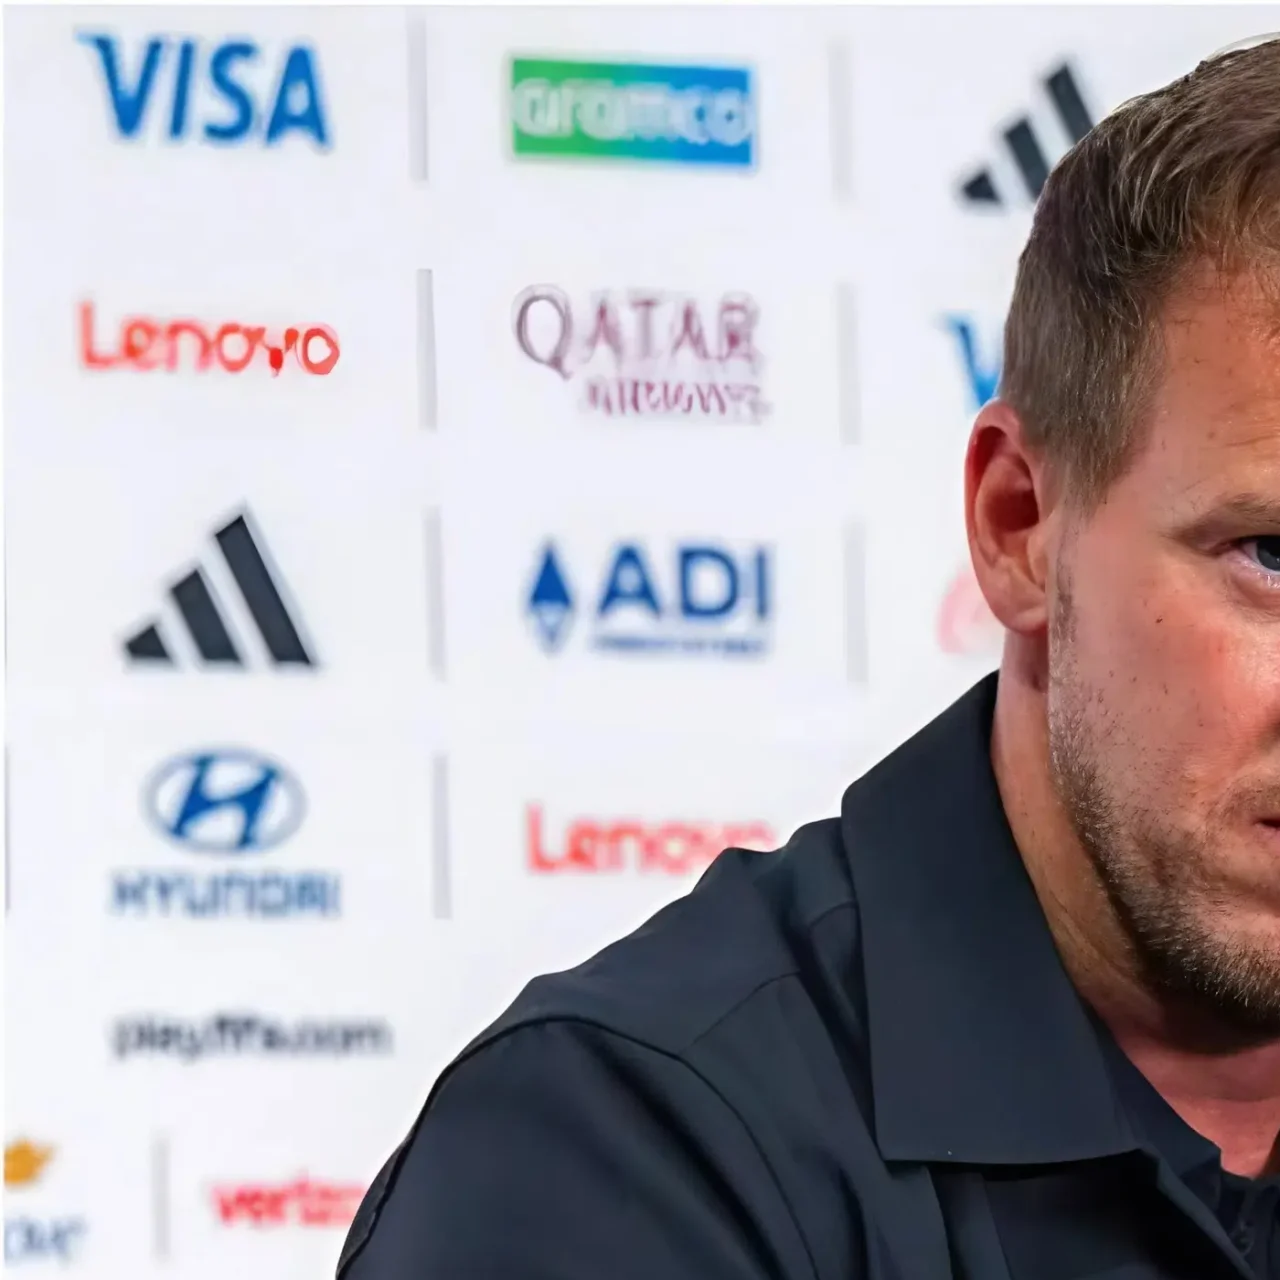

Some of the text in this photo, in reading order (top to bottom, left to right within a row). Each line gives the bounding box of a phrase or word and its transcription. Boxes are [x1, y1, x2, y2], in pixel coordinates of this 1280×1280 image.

[78, 33, 331, 149] VISA
[80, 303, 341, 376] Lenovo
[514, 286, 760, 381] QATAR
[596, 543, 772, 622] ADI
